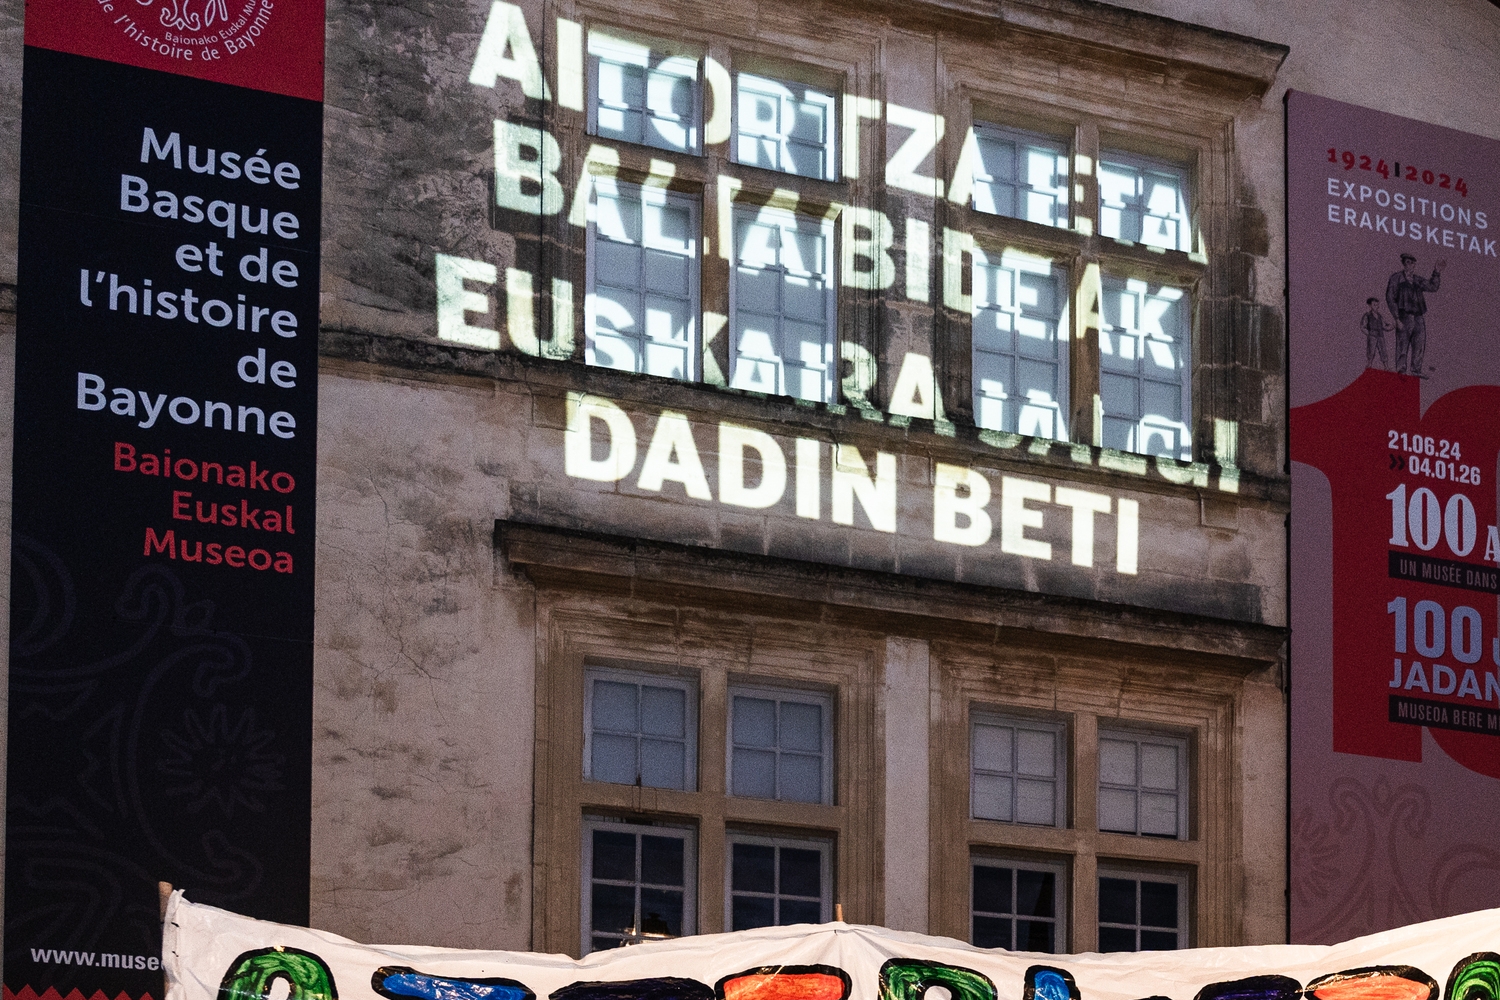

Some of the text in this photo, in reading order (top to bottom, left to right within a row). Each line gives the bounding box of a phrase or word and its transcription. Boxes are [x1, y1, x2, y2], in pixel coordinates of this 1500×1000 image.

[114, 14, 193, 61] l'histoire
[201, 47, 221, 61] de
[224, 0, 274, 55] Bayonne
[165, 32, 218, 46] Baionako
[218, 14, 248, 39] Euskal
[140, 126, 301, 190] Musée
[469, 0, 1209, 265] AITORTZA ETA
[120, 173, 300, 240] Basque
[1327, 177, 1488, 230] EXPOSITIONS
[1327, 203, 1498, 258] ERAKUSKETAK
[175, 241, 299, 289] et de
[79, 268, 299, 339] l'histoire
[236, 347, 298, 389] de
[435, 252, 957, 438] EUSKARA
[76, 371, 297, 440] Bayonne
[113, 441, 297, 494] Baionako
[1387, 430, 1462, 462] 21.06.24
[1408, 455, 1482, 486] 04.01.26
[564, 391, 1139, 576] DADIN BETI
[172, 490, 296, 535] Euskal
[1385, 483, 1477, 557] 100
[143, 527, 294, 574] Museoa
[1399, 558, 1418, 577] UN
[1421, 563, 1462, 585] MUSÉE
[1466, 570, 1498, 590] DANS
[1386, 595, 1483, 665] 100
[1397, 701, 1449, 724] MUSEOA
[1453, 709, 1484, 728] BERE
[30, 947, 163, 971] www.muse
